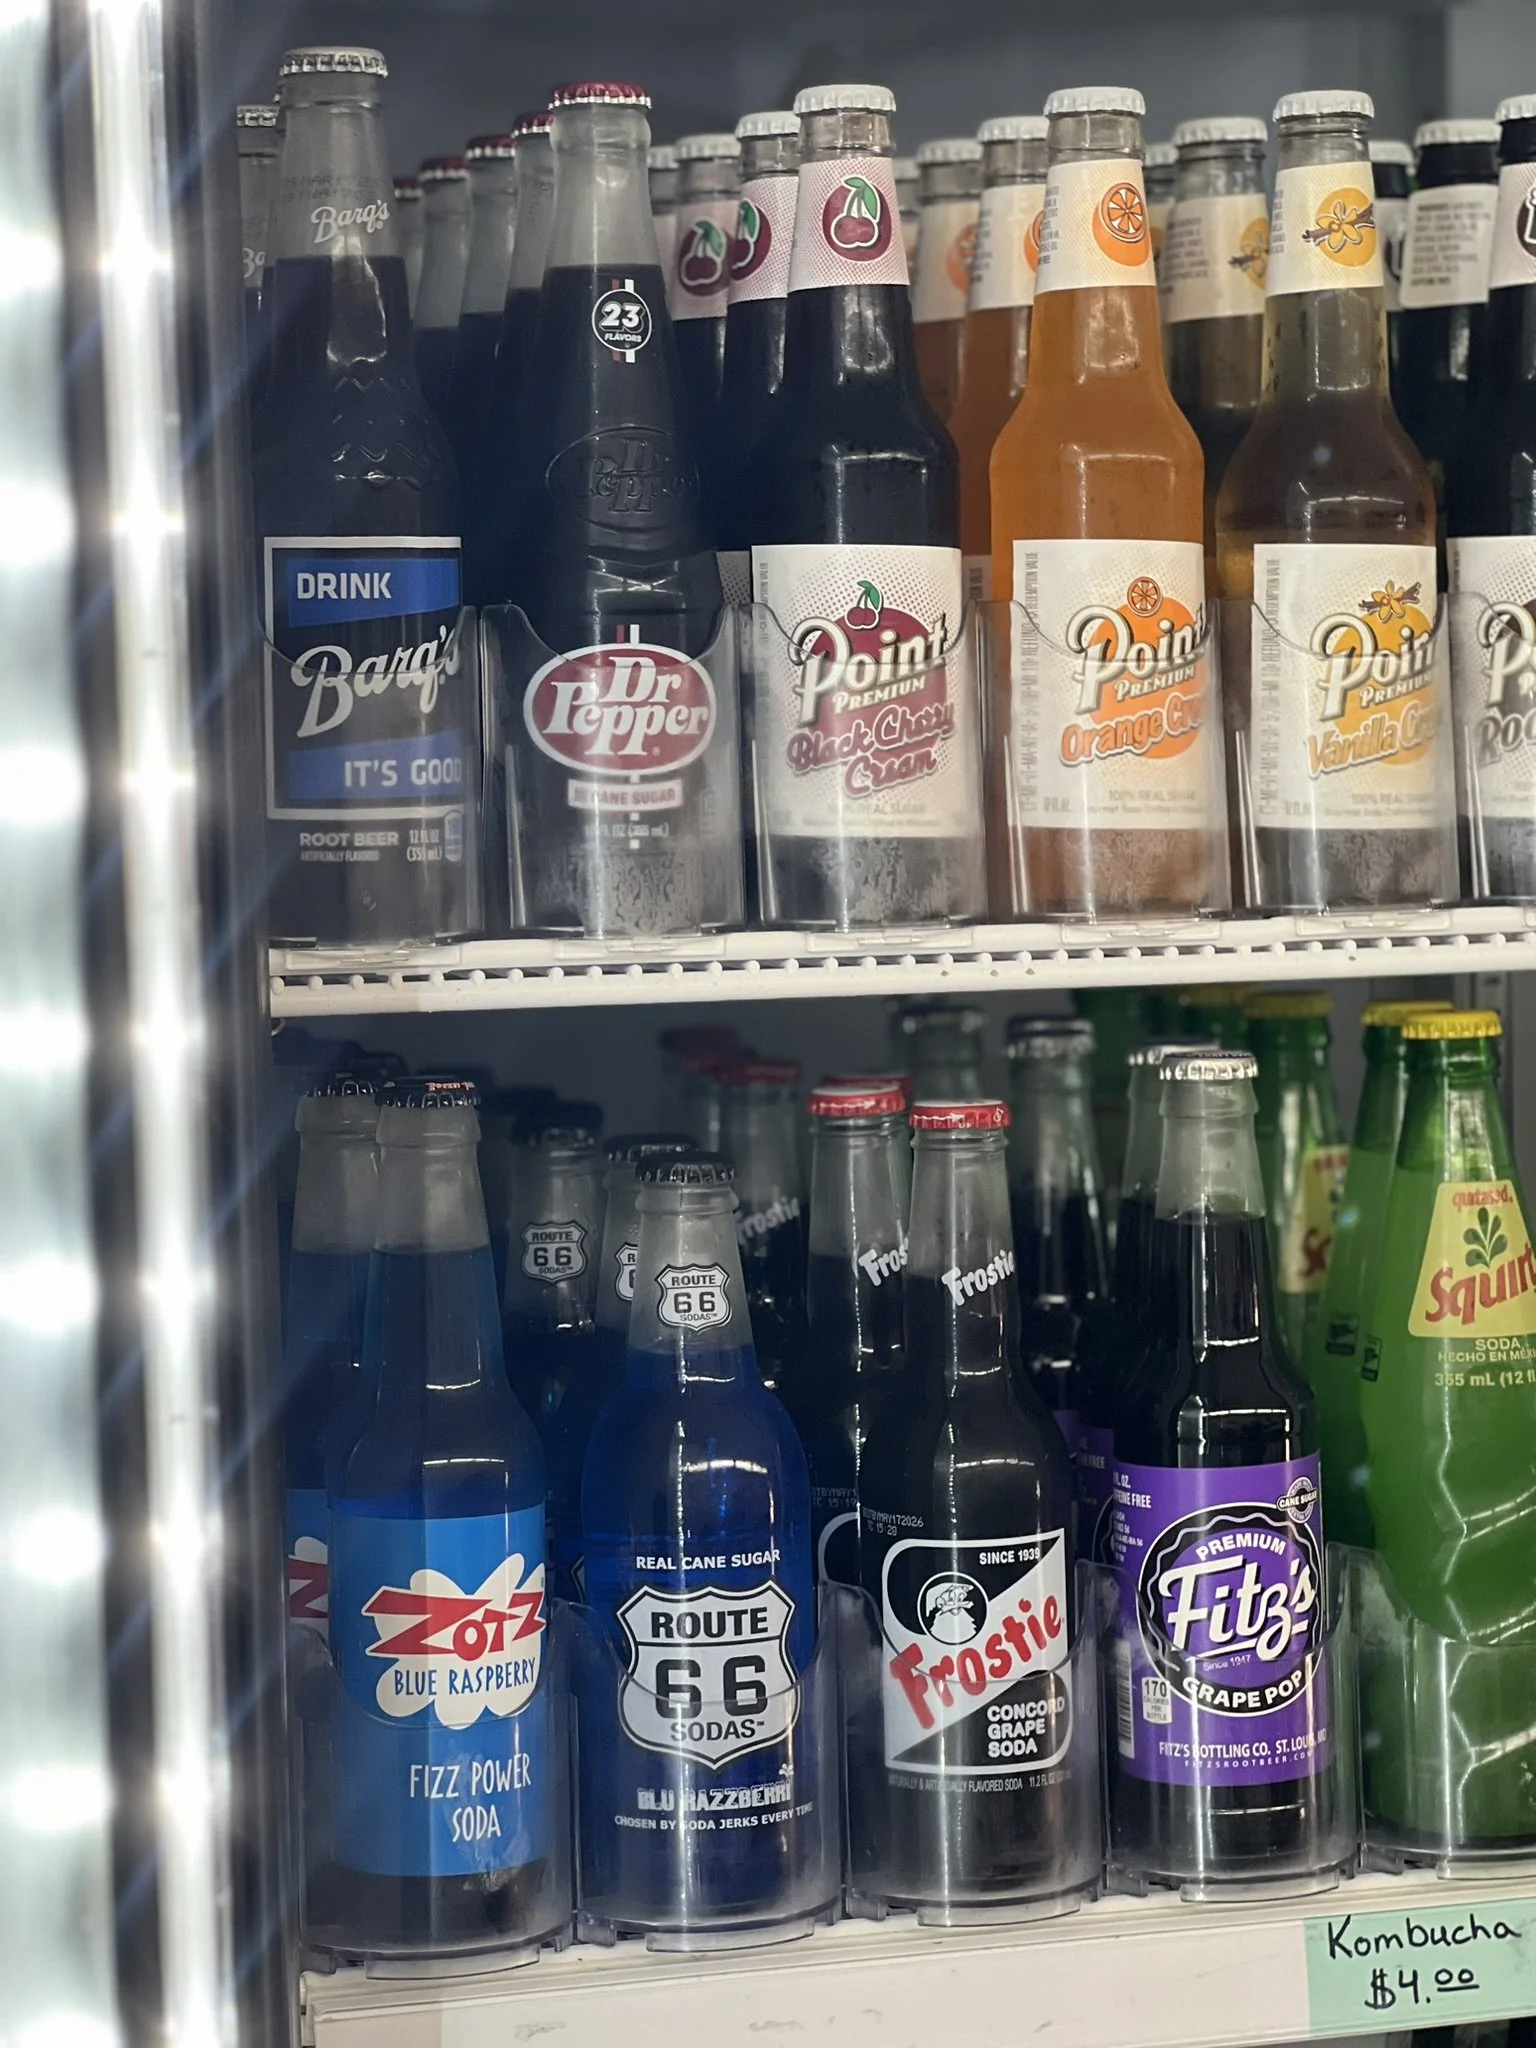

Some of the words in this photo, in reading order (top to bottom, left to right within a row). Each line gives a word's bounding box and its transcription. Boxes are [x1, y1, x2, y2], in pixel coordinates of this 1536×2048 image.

[600, 301, 643, 332] 23
[604, 333, 642, 342] FLAVORS
[297, 572, 392, 599] DRINK
[291, 625, 460, 738] Barq's
[600, 656, 682, 703] Dr
[788, 612, 948, 727] Point
[833, 677, 926, 714] PREMIUM
[1114, 665, 1197, 703] PREMIUM
[541, 682, 710, 756] Pepper
[786, 720, 875, 775] Black
[1061, 709, 1166, 766] Orange
[1307, 713, 1400, 780] Vanilla
[345, 760, 398, 787] IT'S
[845, 748, 938, 798] Cream
[632, 788, 676, 804] SUGAR
[300, 833, 350, 846] ROOT
[354, 831, 400, 846] BEER
[532, 1231, 573, 1241] ROUTE
[533, 1246, 572, 1266] 66
[672, 1275, 716, 1286] ROUTE
[674, 1291, 715, 1313] 66
[1438, 1351, 1486, 1363] HECHO
[1489, 1350, 1507, 1361] EN
[1475, 1337, 1521, 1351] SODA
[1470, 1372, 1495, 1387] mL
[1499, 1370, 1524, 1389] (12
[1131, 1493, 1151, 1508] FREE
[1279, 1496, 1300, 1509] CANE
[636, 1556, 677, 1570] REAL
[682, 1555, 726, 1570] CANE
[731, 1549, 780, 1568] SUGAR
[979, 1550, 1014, 1565] SINCE
[1017, 1547, 1040, 1562] 1939
[1195, 1532, 1286, 1562] PREMIUM
[1158, 1555, 1316, 1662] Fitz's
[651, 1607, 768, 1639] ROUTE
[890, 1595, 1062, 1730] Frostie
[1203, 1660, 1228, 1671] Since
[1229, 1653, 1251, 1668] 1947
[395, 1670, 437, 1696] BLUE
[449, 1657, 536, 1695] RASPBERRY
[655, 1655, 768, 1719] 66
[1144, 1679, 1167, 1698] 170
[1182, 1676, 1261, 1709] GRAPE
[1265, 1669, 1303, 1704] POP
[987, 1718, 1046, 1740] GRAPE
[988, 1738, 1038, 1758] SODA
[1159, 1741, 1190, 1757] FITZ'S
[1193, 1744, 1250, 1759] BOTTLING
[1252, 1742, 1271, 1756] CO.
[1276, 1740, 1290, 1754] ST.
[410, 1764, 460, 1798] FIZZ
[471, 1753, 531, 1796] POWER
[968, 1780, 1003, 1792] FLAVORED
[1004, 1778, 1023, 1791] SODA
[637, 1787, 675, 1811] BLU
[452, 1804, 501, 1842] SODA
[614, 1815, 656, 1829] CHOSEN
[660, 1819, 676, 1830] BY
[682, 1819, 716, 1830] SODA
[719, 1816, 758, 1830] JERKS
[761, 1808, 794, 1825] EVERY
[1328, 1914, 1522, 1959] Kombucha
[1364, 1967, 1480, 2011] $4.00
